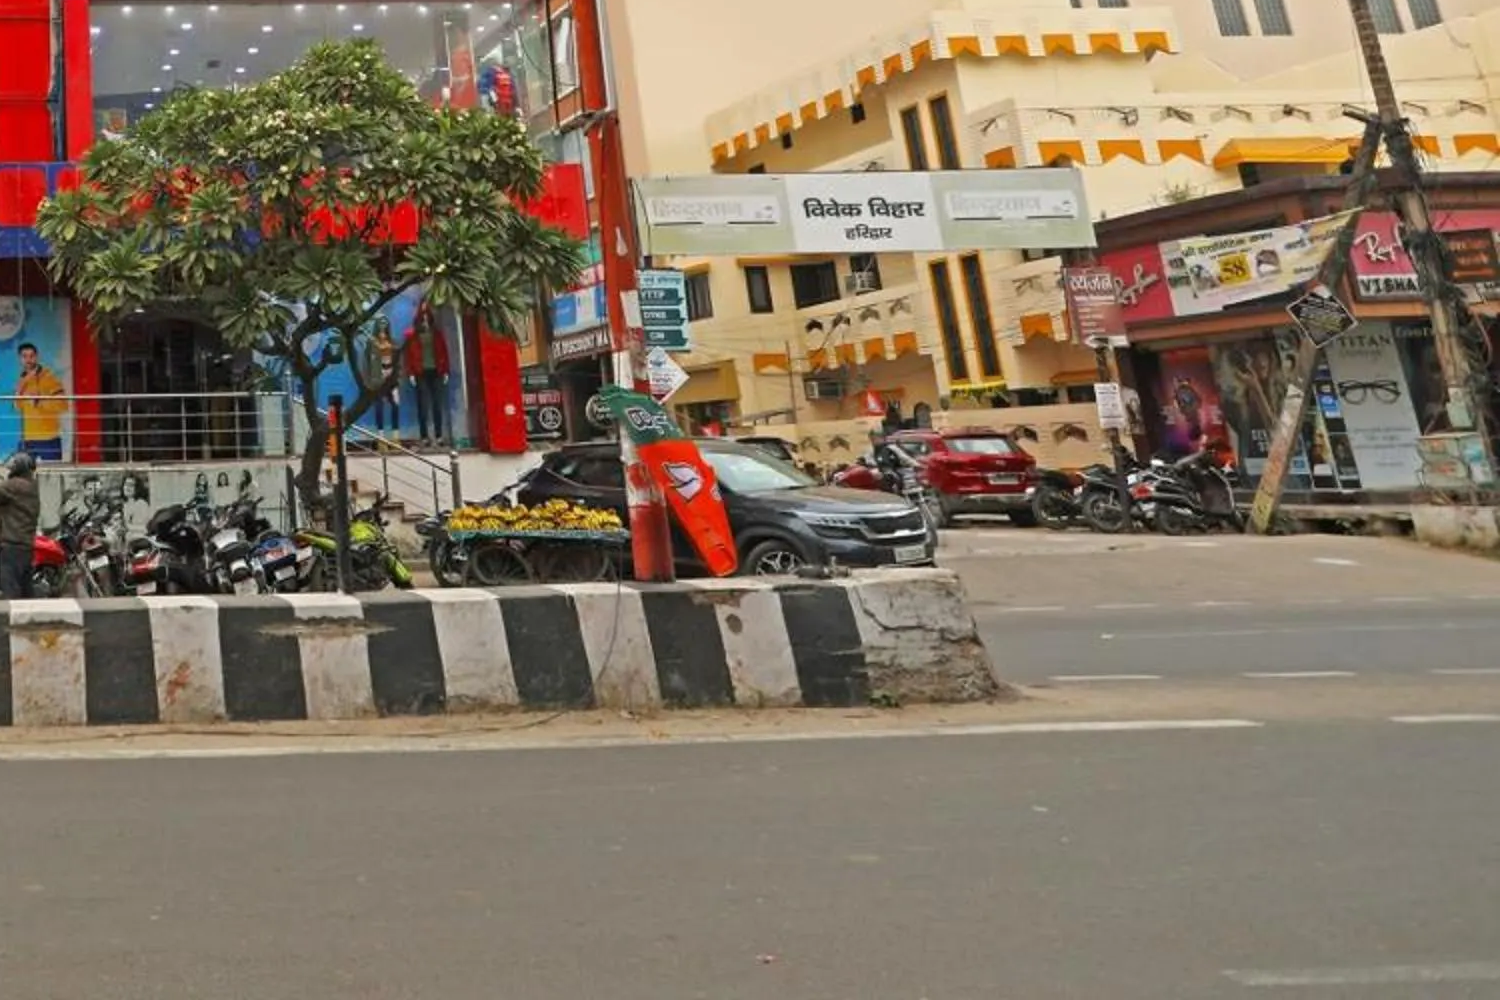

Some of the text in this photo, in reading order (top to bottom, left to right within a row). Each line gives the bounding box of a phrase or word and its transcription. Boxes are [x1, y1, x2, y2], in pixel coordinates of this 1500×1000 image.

[803, 197, 925, 219] विवेक विहार
[844, 223, 893, 241] हरिद्वार
[1359, 277, 1421, 294] VISHA
[1339, 333, 1392, 347] TITAN
